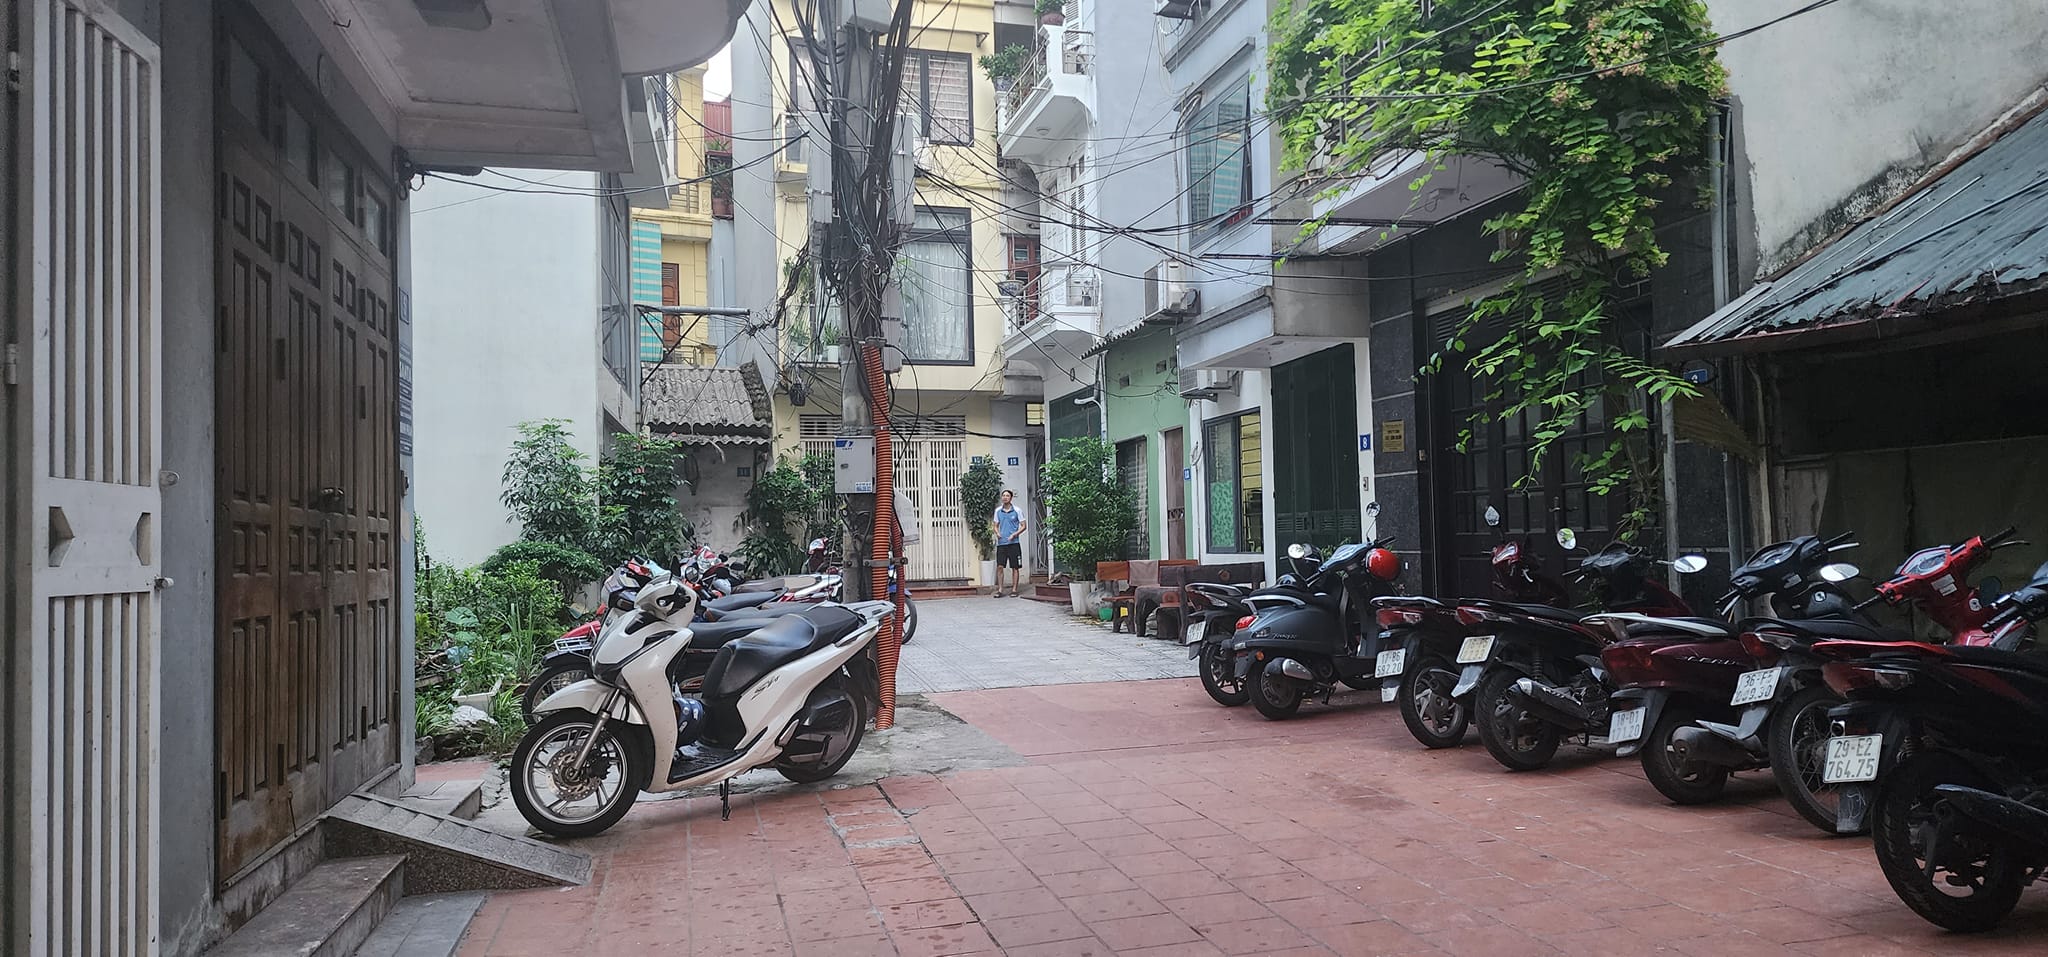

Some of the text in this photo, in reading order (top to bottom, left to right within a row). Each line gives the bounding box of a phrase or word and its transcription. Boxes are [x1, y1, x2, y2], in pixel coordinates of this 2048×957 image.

[1362, 436, 1368, 449] 8
[1833, 737, 1873, 758] 29-E2
[1826, 758, 1876, 780] 764.75
